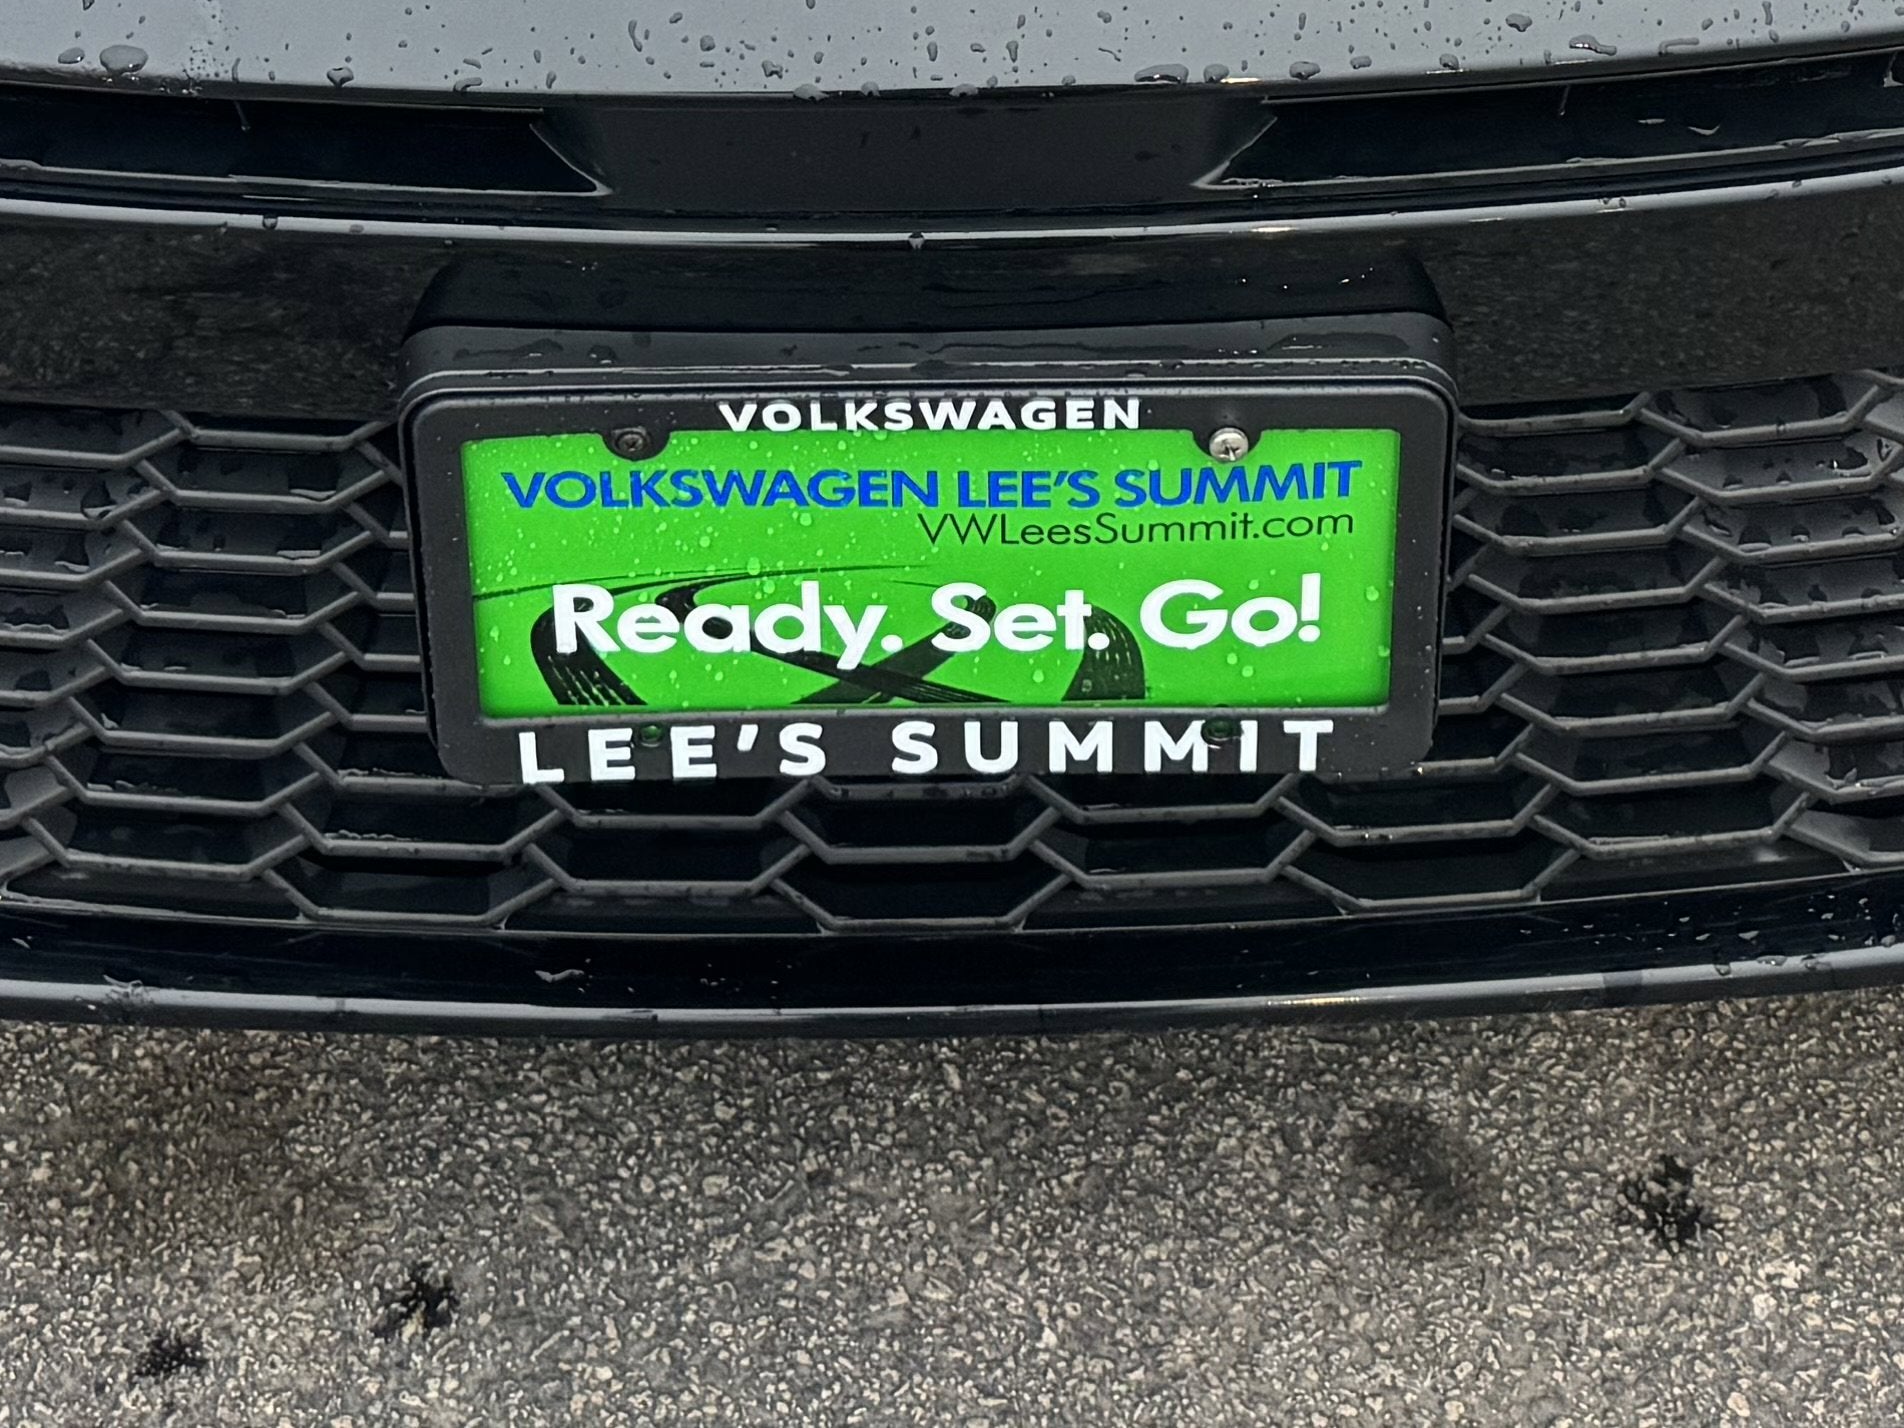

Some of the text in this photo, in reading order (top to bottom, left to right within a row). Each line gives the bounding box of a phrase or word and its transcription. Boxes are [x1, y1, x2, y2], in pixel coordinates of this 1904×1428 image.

[717, 398, 1141, 432] VOLKSWAGEN
[500, 460, 1363, 509] VOLKSWAGEN LEE'S SUMMIT
[916, 511, 1354, 545] VWLeesSummit.com
[551, 571, 1322, 671] Ready. Set. Go!
[517, 719, 1335, 785] LEE'S SUMMIT
